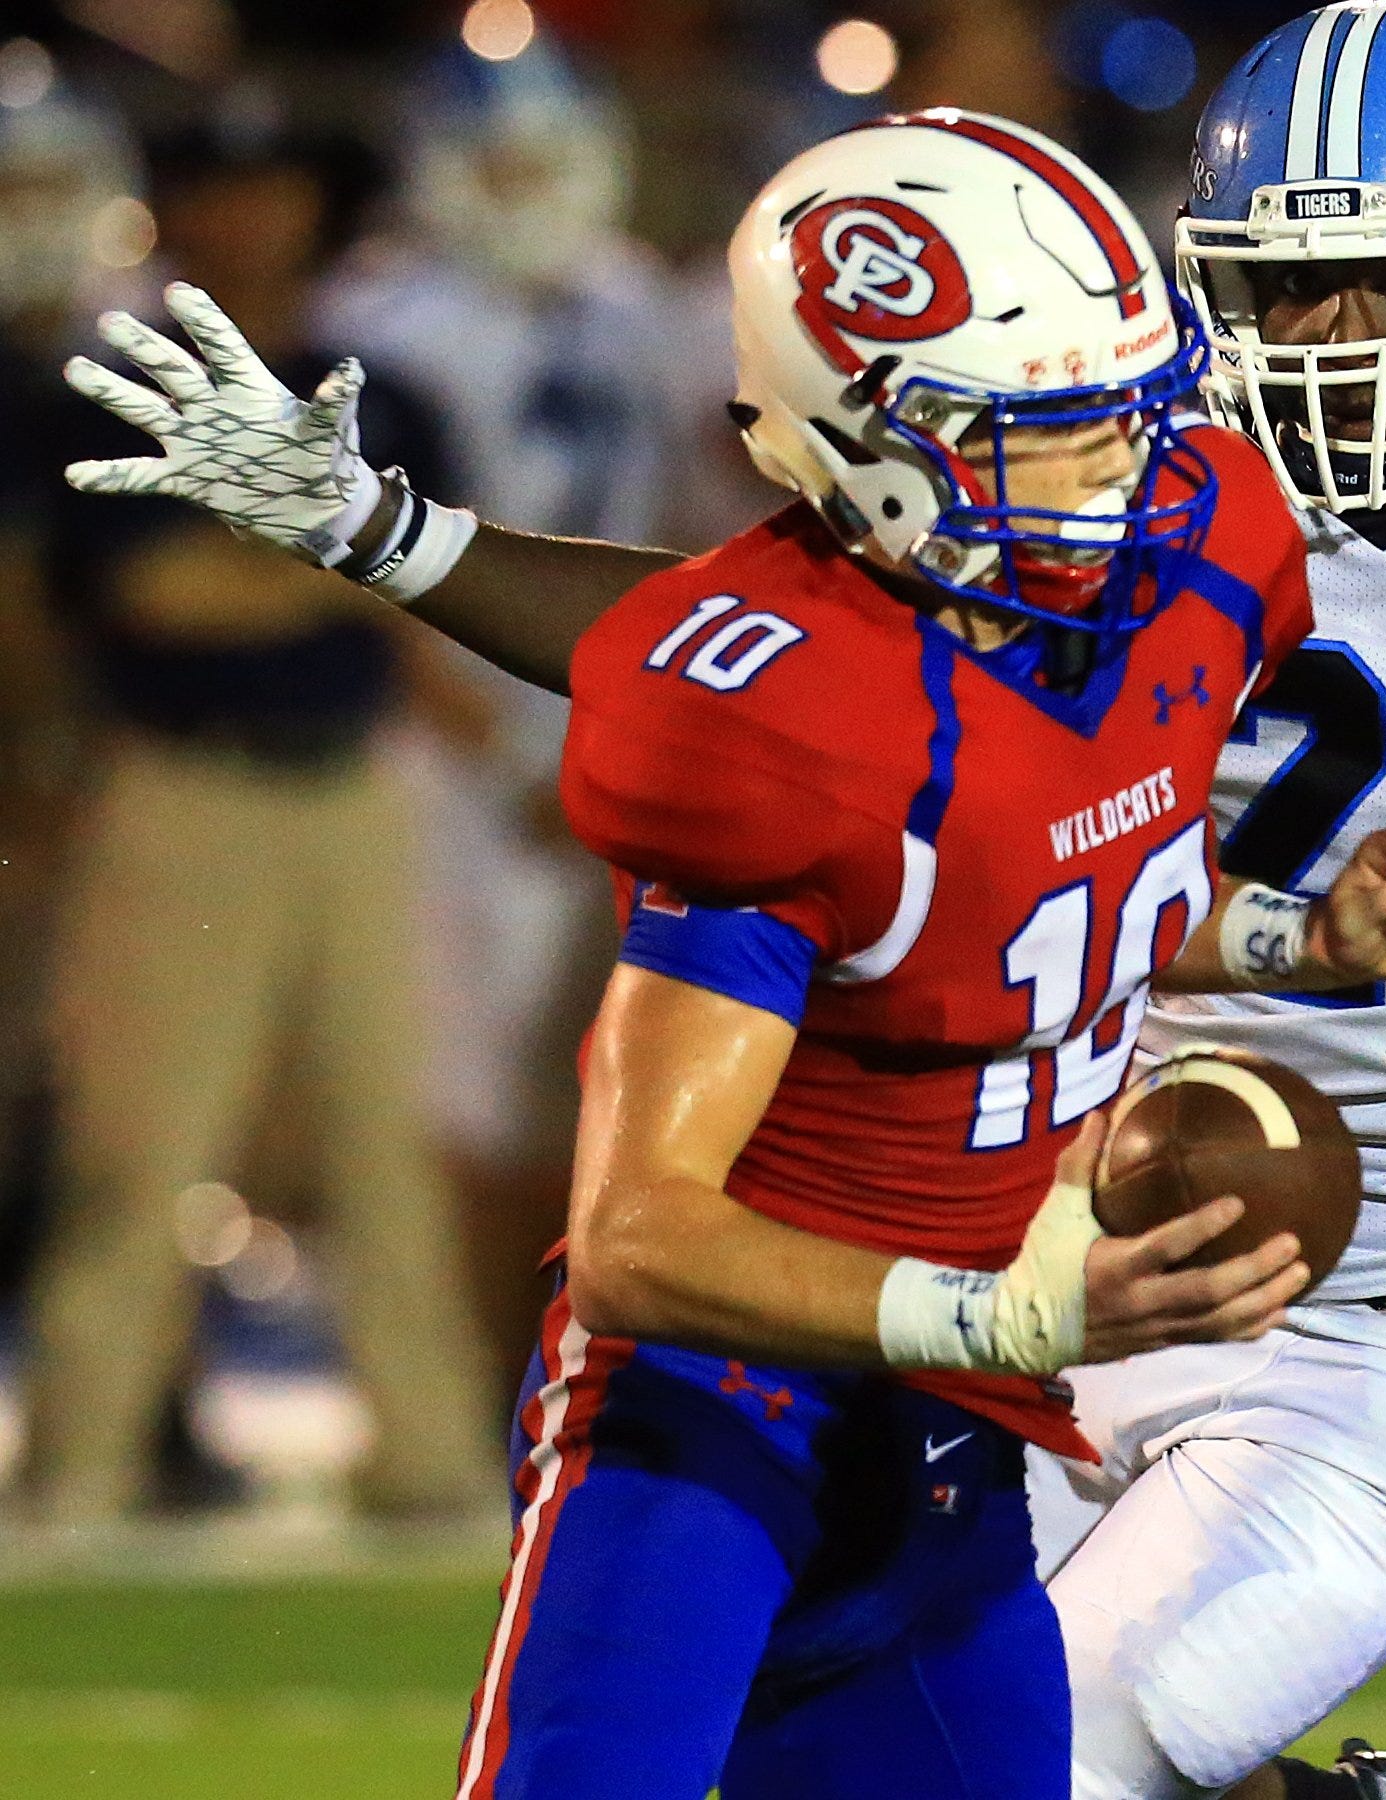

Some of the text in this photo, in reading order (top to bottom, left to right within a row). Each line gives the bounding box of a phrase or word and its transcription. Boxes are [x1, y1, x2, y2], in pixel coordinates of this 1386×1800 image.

[1295, 192, 1350, 217] TIGERS
[642, 593, 808, 692] 10
[1049, 766, 1177, 862] WILDCATS
[965, 816, 1212, 1153] 10
